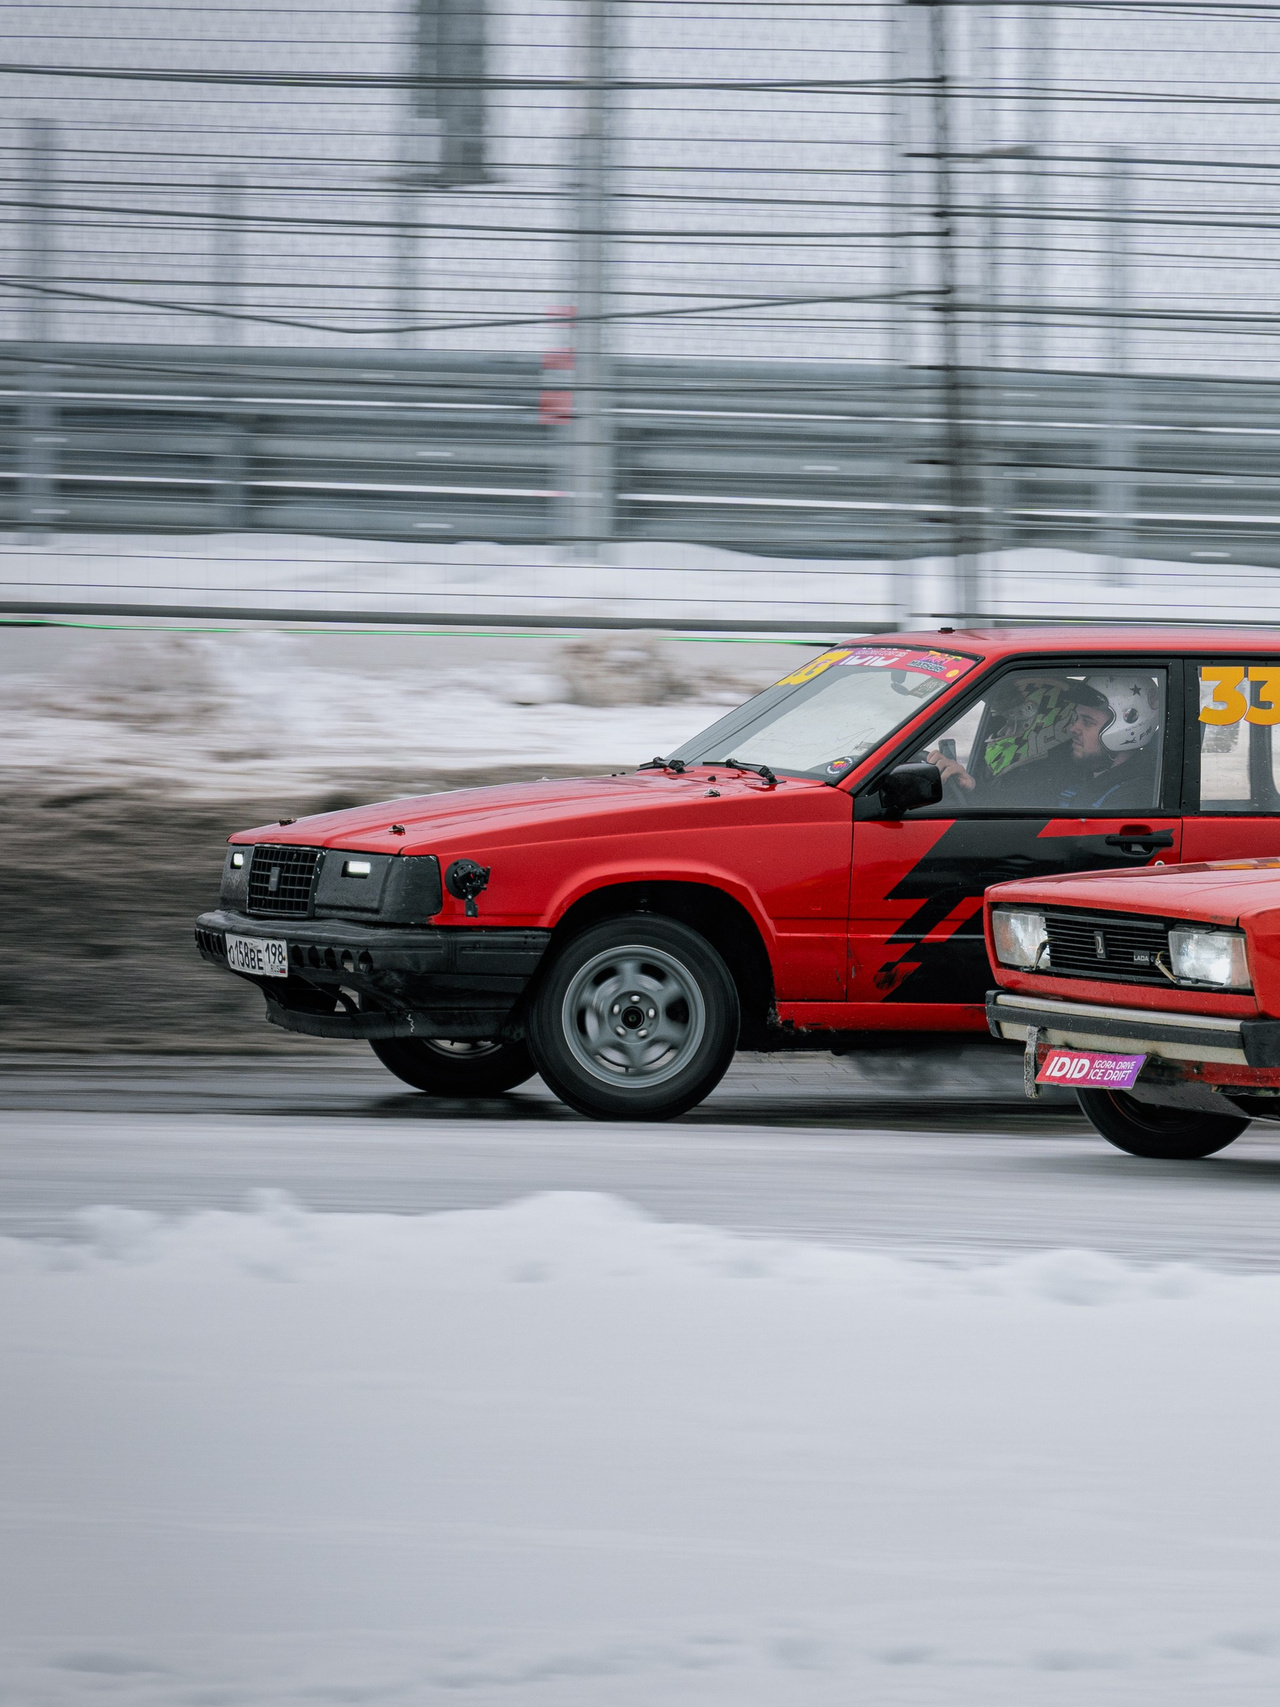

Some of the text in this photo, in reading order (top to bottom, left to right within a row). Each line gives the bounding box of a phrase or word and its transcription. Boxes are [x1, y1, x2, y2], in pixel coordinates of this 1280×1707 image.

[265, 943, 283, 964] 198
[1045, 1056, 1091, 1079] IDID
[1093, 1060, 1136, 1070] IGORA DRIVE
[1087, 1069, 1132, 1081] ICE DRIFT
